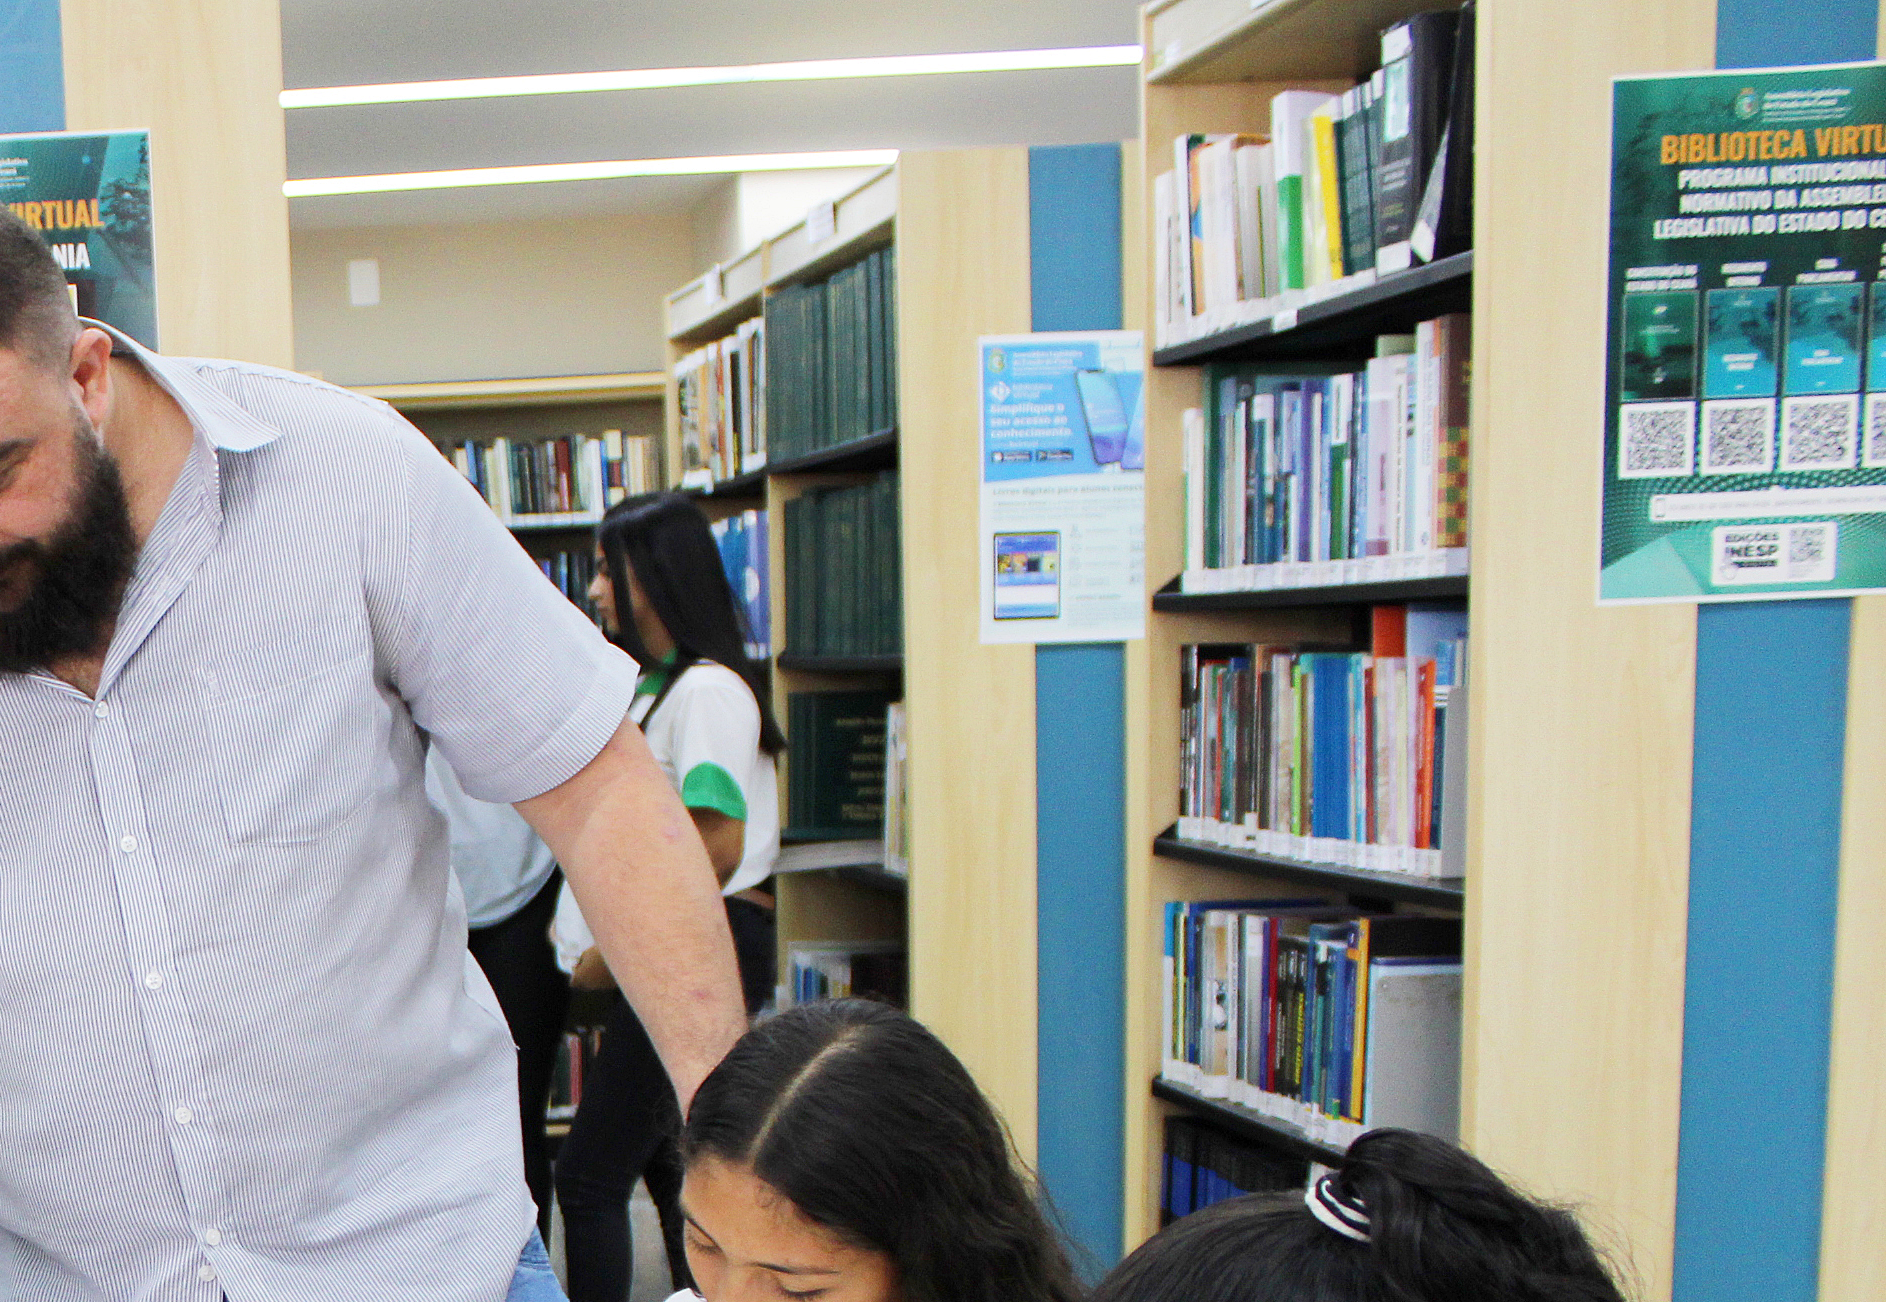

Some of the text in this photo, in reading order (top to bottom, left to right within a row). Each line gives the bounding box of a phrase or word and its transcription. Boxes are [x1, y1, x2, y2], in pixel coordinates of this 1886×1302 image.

[1660, 129, 1808, 165] BIBLIOTECA
[1677, 166, 1769, 190] PROGRAMA
[8, 198, 106, 229] IRTUAL
[1679, 190, 1772, 214] NORMATIVO
[1773, 188, 1798, 210] DA
[1652, 215, 1751, 240] LEGISLATIVA
[1751, 213, 1776, 235] DO
[1778, 210, 1840, 234] ESTADO
[1841, 208, 1868, 231] DO
